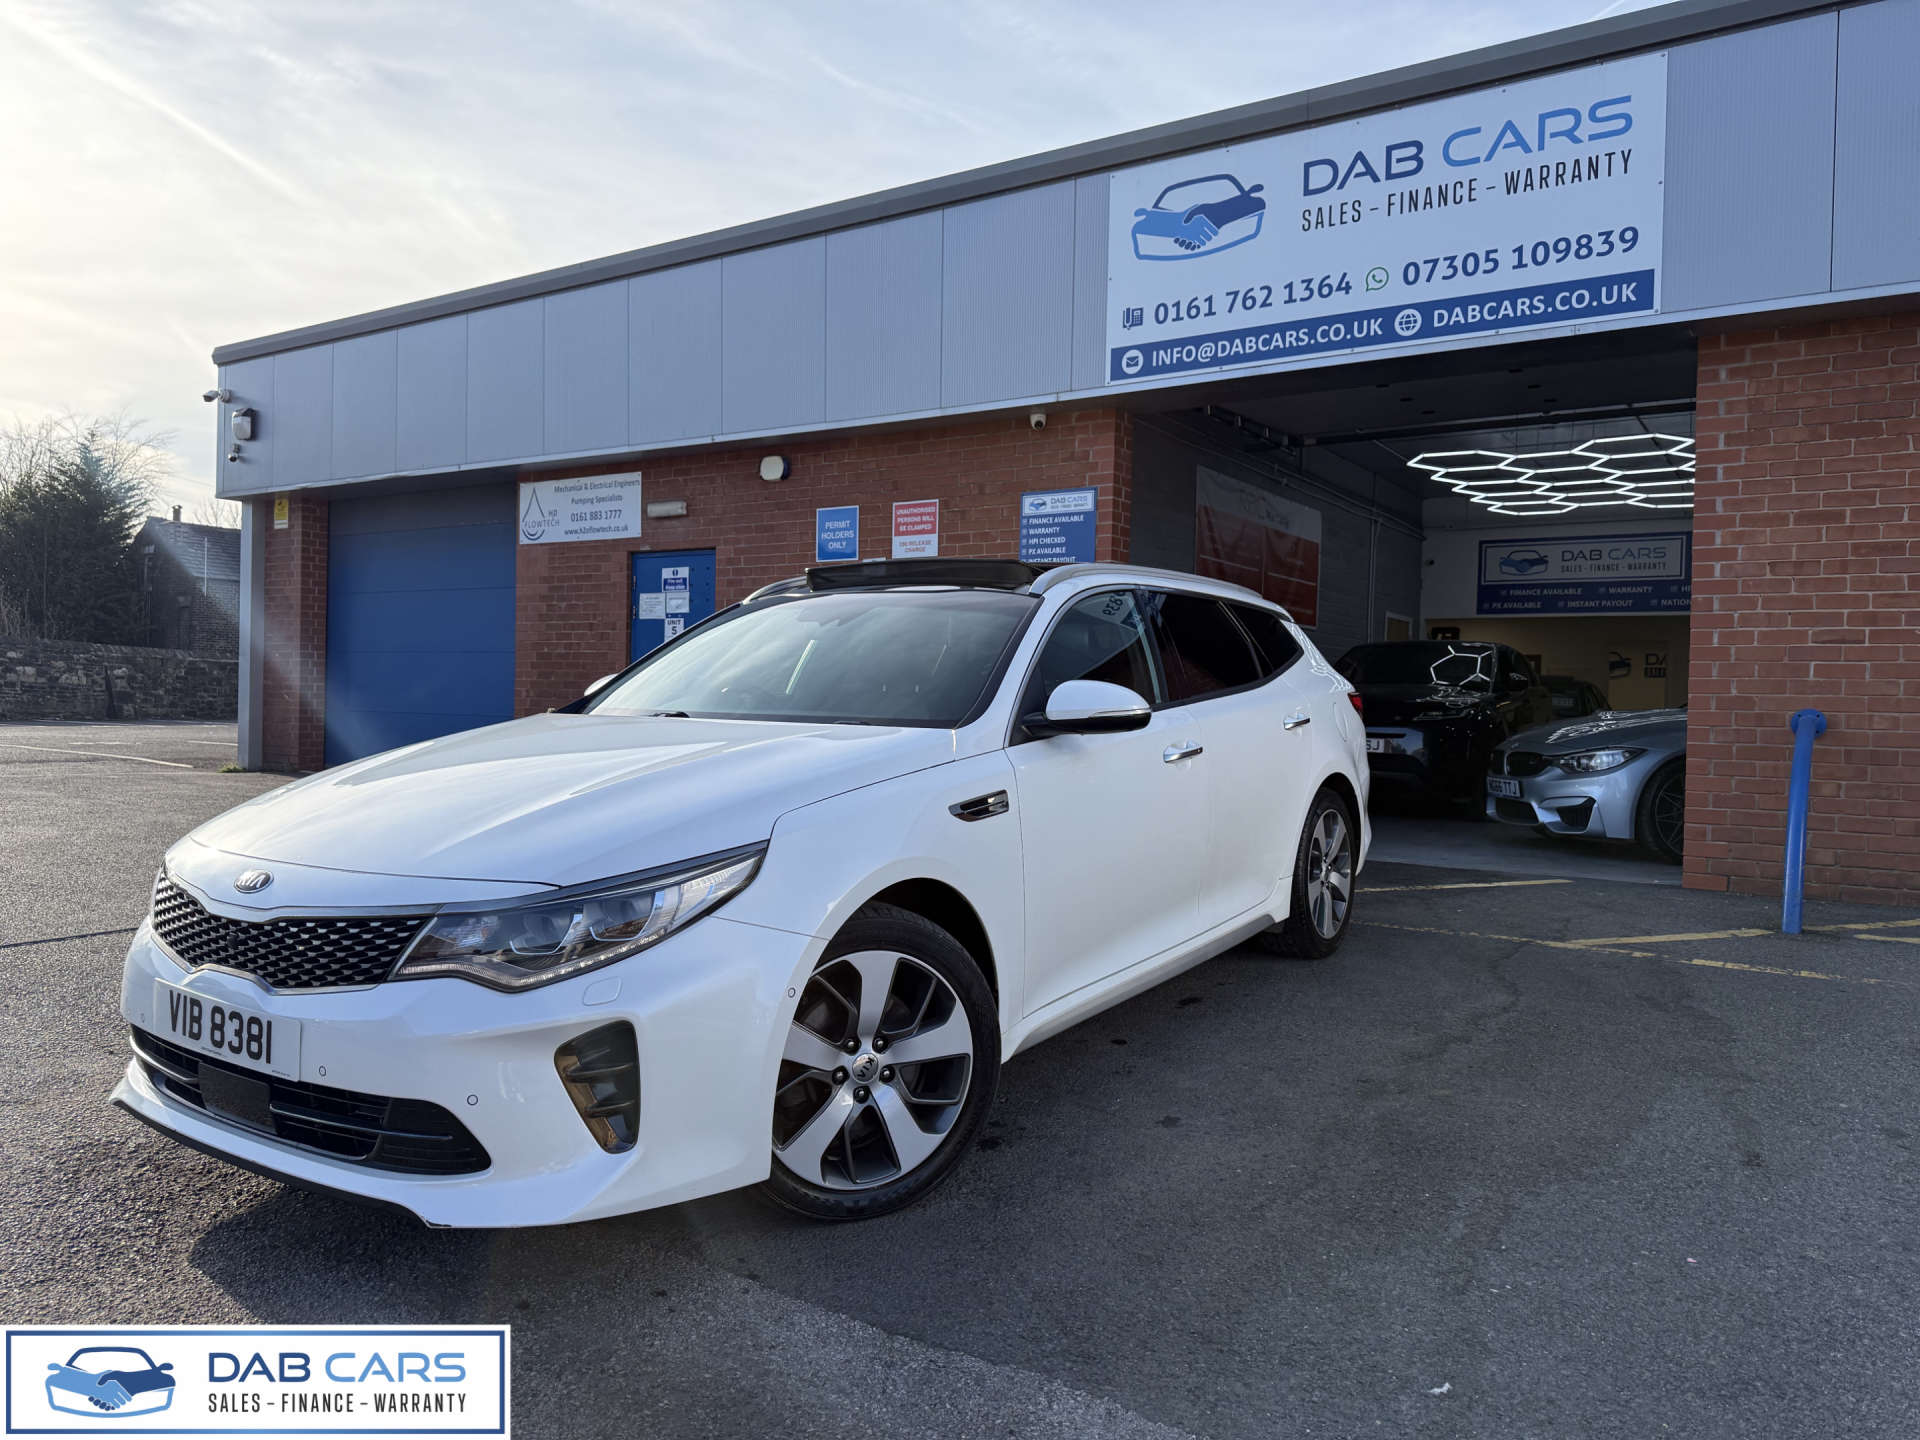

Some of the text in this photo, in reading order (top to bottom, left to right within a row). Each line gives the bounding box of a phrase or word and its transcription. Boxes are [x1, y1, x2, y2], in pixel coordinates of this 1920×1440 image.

[1303, 95, 1633, 197] DAB CARS
[1301, 200, 1362, 232] SALES
[1387, 178, 1478, 217] FINANCE
[1504, 149, 1633, 196] WARRANTY
[1402, 225, 1640, 287] 07305 109839
[1153, 271, 1353, 326] 0161 762 1364
[1432, 281, 1638, 330] DABCARS.CO.UK
[1151, 316, 1384, 368] INFO@DABCARS.CO.UK
[570, 512, 588, 522] 0161
[605, 509, 622, 520] 1777
[1028, 514, 1084, 525] FINANCE AVAILABLE
[825, 520, 850, 530] PERMIT
[1028, 526, 1060, 535] WARRANTY
[821, 530, 855, 540] HOLDERS
[1040, 536, 1066, 545] CHECKED
[828, 541, 847, 550] ONLY
[1037, 546, 1066, 555] AVAILABLE
[1561, 547, 1667, 562] DAB CARS
[1560, 561, 1667, 573] SALES FINANCE WARRANTY
[1509, 587, 1582, 597] FINANCE AVAILABLE
[1608, 585, 1653, 594] WARRANTY
[1503, 601, 1542, 609] AVAILABLE
[1567, 599, 1633, 608] INSTANT PAYOUT
[671, 626, 677, 635] 5
[236, 870, 266, 889] KIA
[169, 990, 273, 1065] VIB 8381
[857, 1057, 875, 1077] KIA
